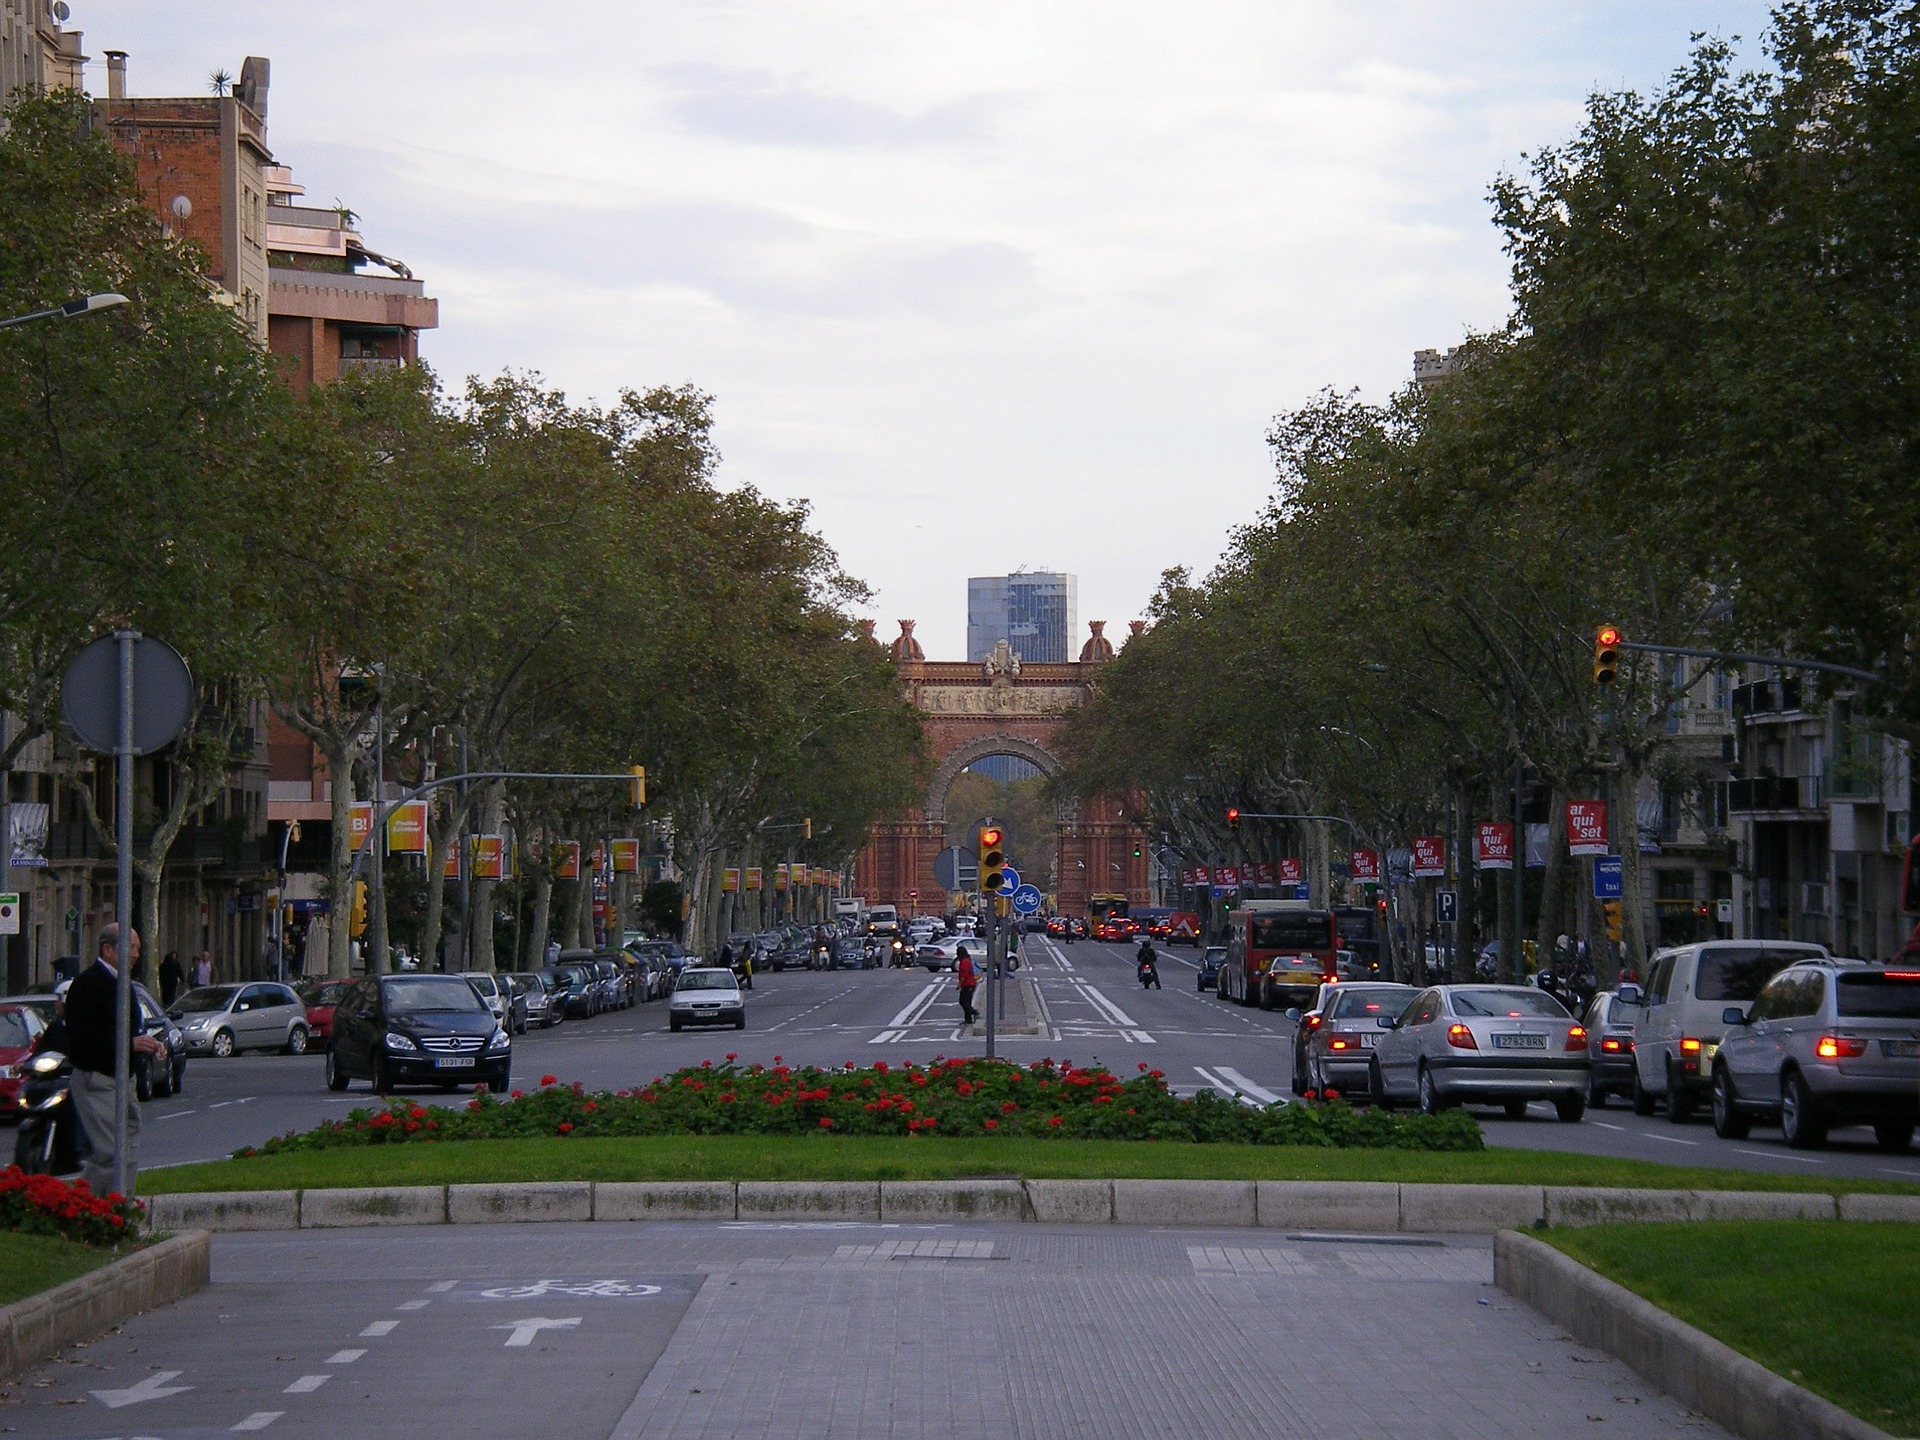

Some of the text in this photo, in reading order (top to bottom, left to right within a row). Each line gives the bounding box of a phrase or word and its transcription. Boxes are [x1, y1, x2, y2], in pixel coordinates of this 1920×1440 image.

[1569, 804, 1585, 816] ar
[352, 817, 367, 831] B!
[1572, 812, 1594, 830] qui
[1481, 826, 1495, 836] ar
[1580, 826, 1602, 838] set
[1416, 840, 1427, 848] ar
[1483, 833, 1502, 848] qui
[1417, 845, 1434, 858] qui
[1488, 844, 1508, 855] set
[1353, 852, 1363, 860] ar
[1422, 855, 1439, 865] set
[1355, 857, 1369, 868] qui
[1360, 865, 1374, 874] set
[1605, 882, 1620, 891] taxi
[1442, 894, 1452, 911] P
[1501, 1037, 1544, 1046] 2782 BRN
